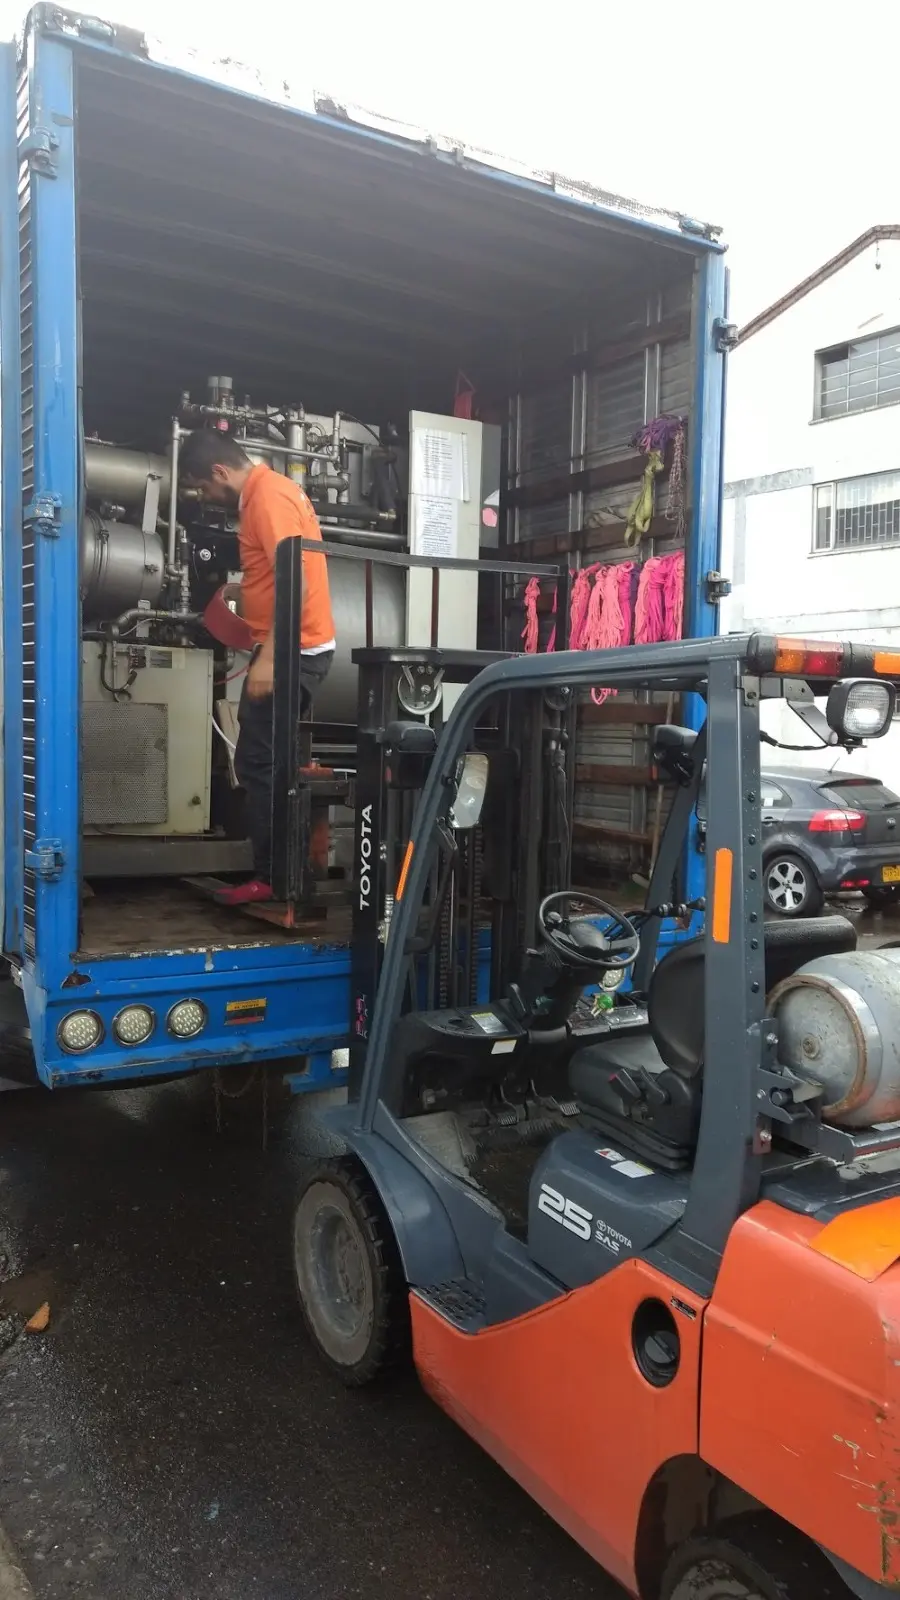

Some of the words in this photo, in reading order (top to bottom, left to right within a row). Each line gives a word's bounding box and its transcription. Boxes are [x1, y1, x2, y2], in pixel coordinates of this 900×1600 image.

[359, 804, 373, 911] TOYOTA
[538, 1183, 593, 1241] 25
[594, 1230, 620, 1252] SAS
[606, 1225, 632, 1249] TOYOTA
